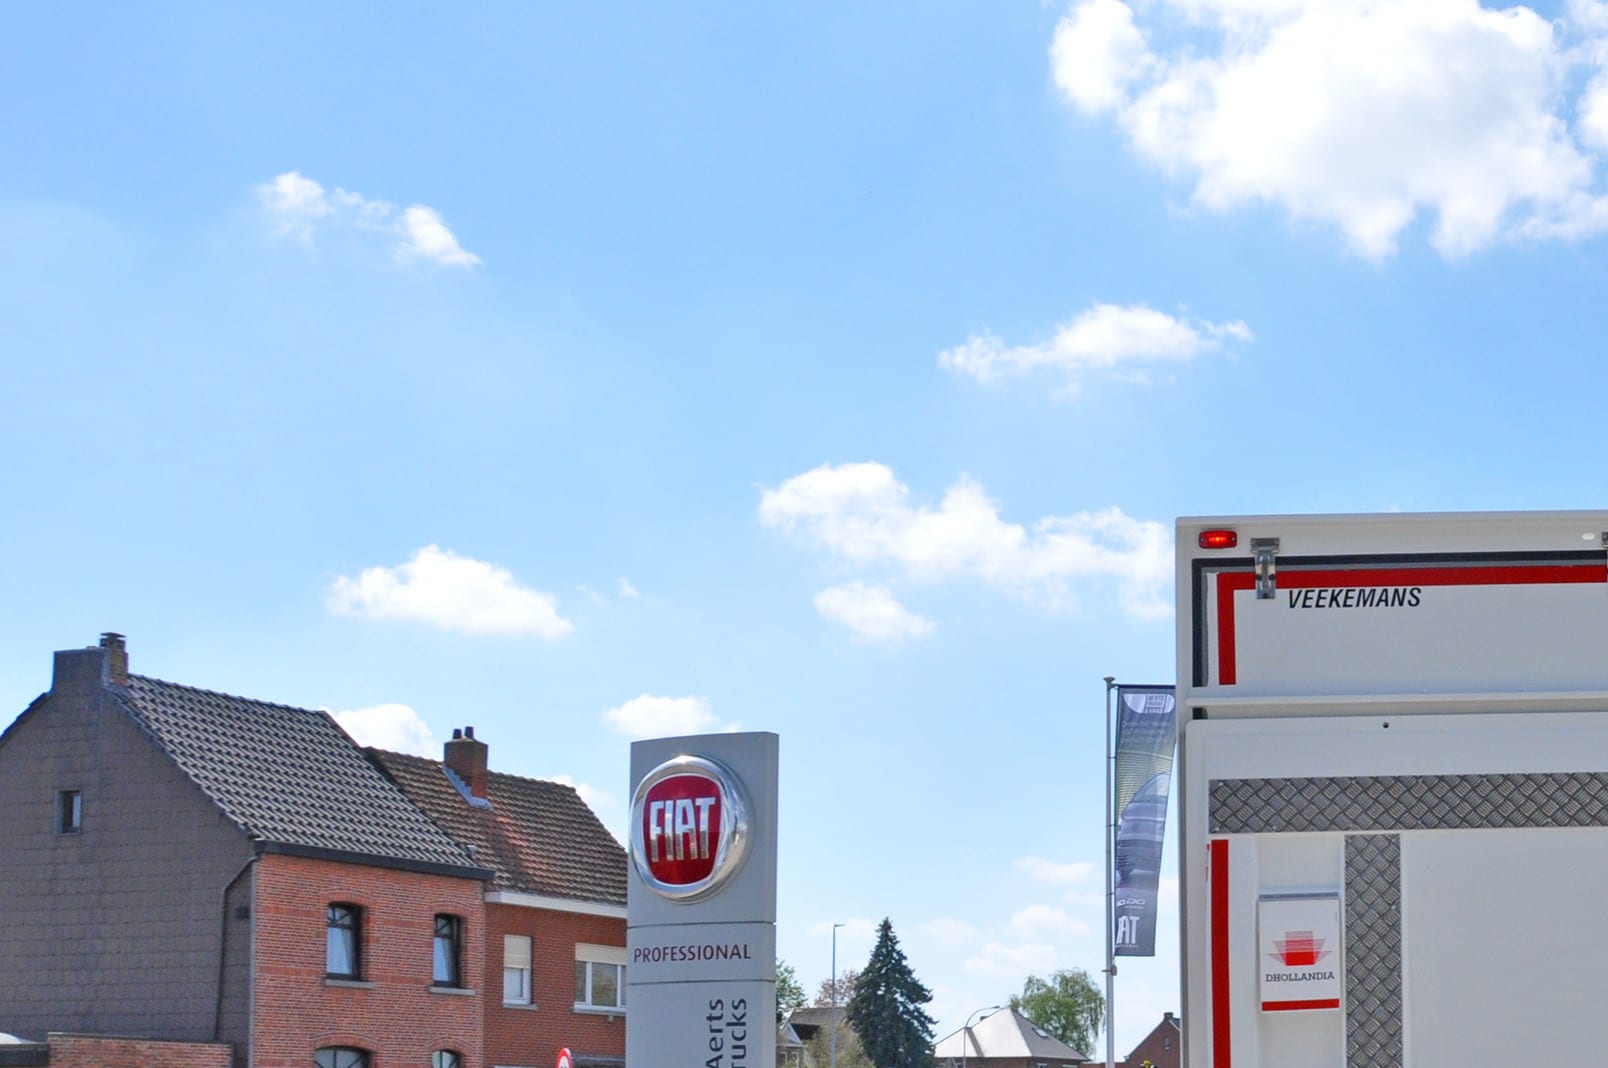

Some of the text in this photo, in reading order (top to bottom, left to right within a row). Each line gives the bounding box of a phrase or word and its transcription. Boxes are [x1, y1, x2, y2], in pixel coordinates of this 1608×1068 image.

[1288, 587, 1422, 608] VEEKEMANS
[650, 797, 716, 862] FIAT
[633, 944, 752, 963] PROFESSIONAL
[1265, 971, 1335, 983] DHOLLANDIA
